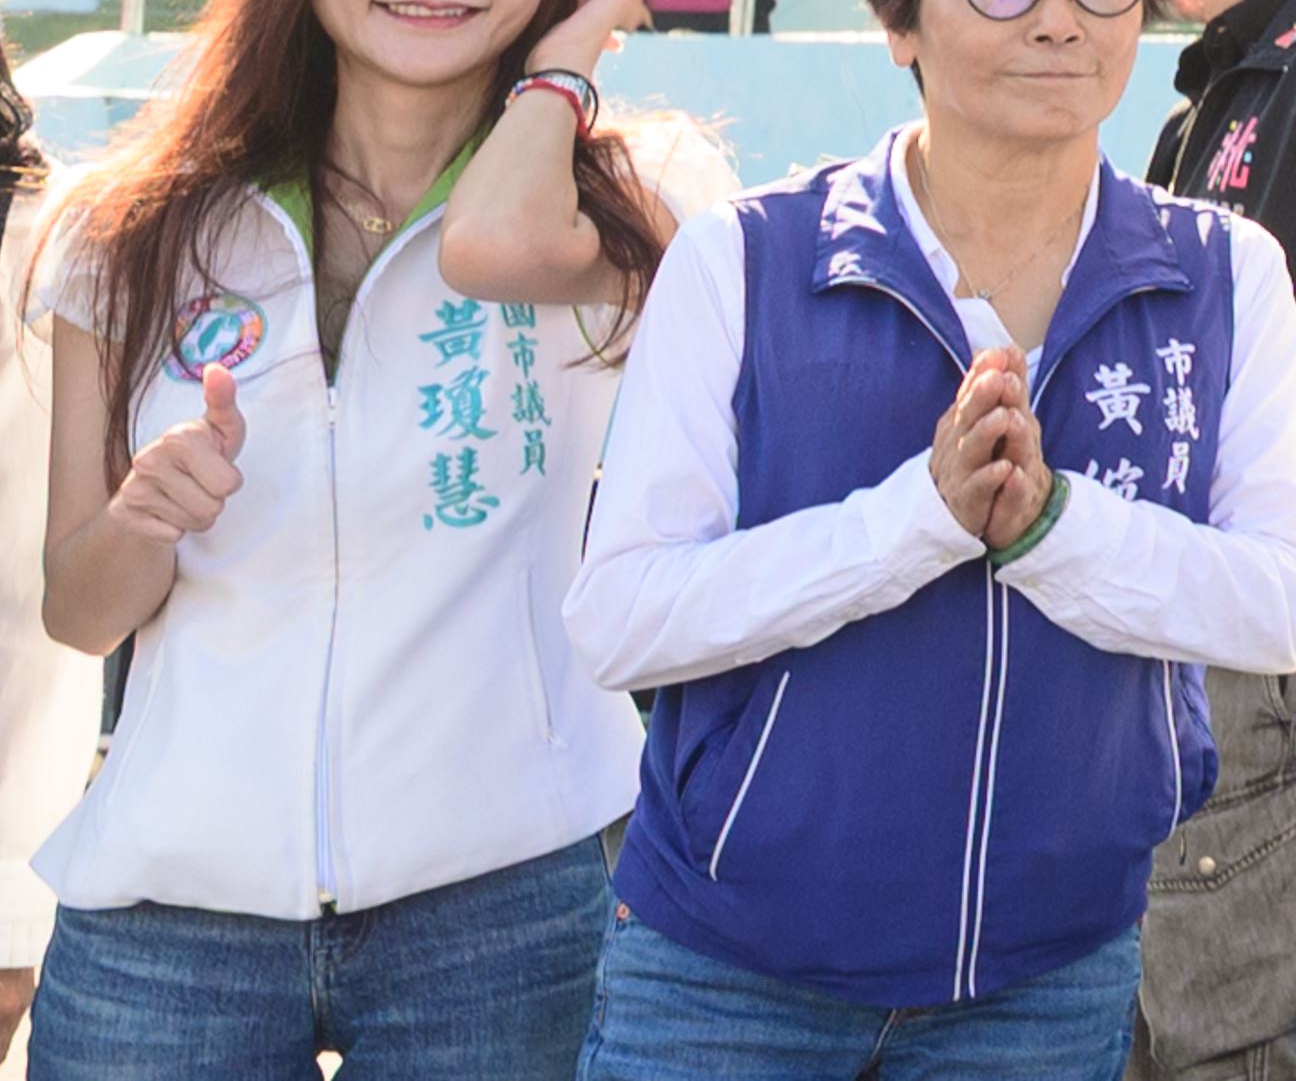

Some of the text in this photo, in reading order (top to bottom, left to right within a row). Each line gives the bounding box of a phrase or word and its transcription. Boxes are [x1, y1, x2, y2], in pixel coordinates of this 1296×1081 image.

[418, 298, 499, 531] 黃瓊慧
[1156, 339, 1199, 494] 市議員
